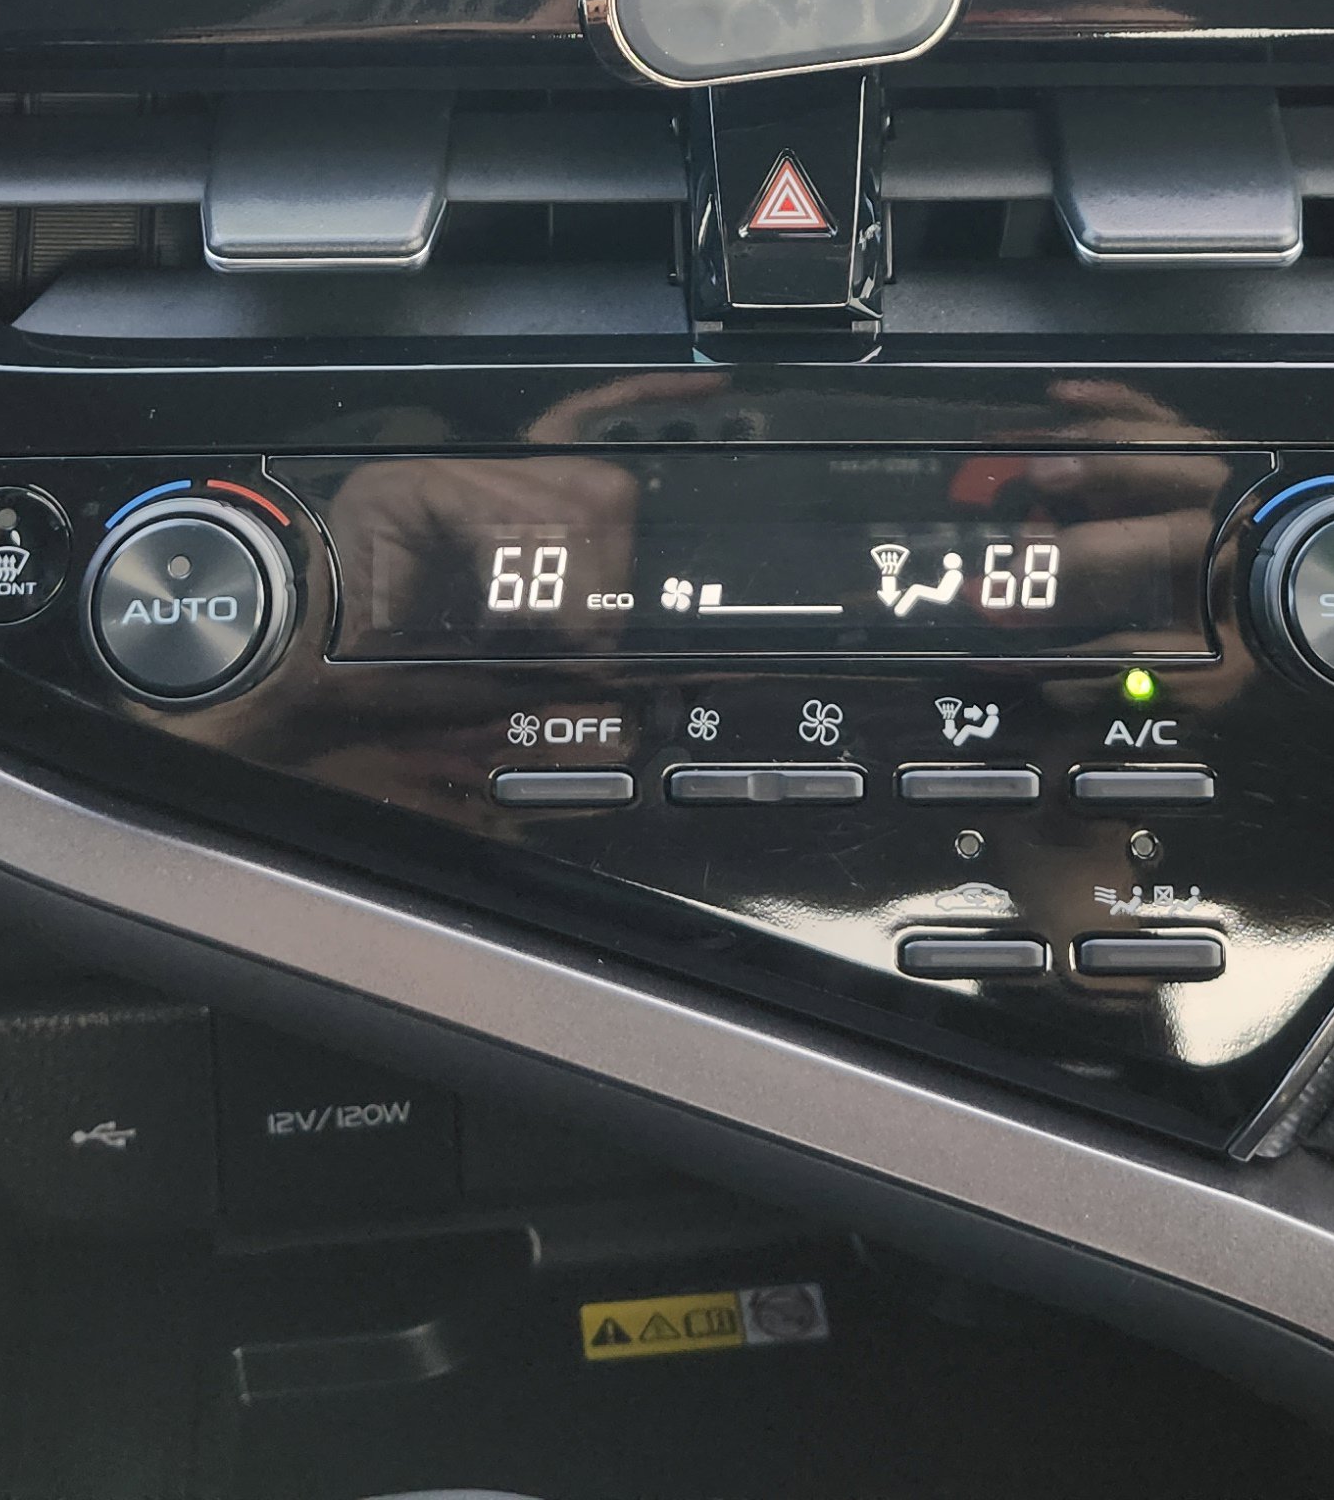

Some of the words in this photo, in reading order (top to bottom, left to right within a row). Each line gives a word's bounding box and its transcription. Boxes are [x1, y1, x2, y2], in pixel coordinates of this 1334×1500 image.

[488, 546, 569, 612] 68
[586, 592, 635, 611] ECO
[980, 544, 1061, 611] 68
[121, 595, 239, 627] AUTO
[543, 716, 623, 745] OFF
[1103, 719, 1179, 746] A/C
[267, 1100, 412, 1136] 12V/120W
